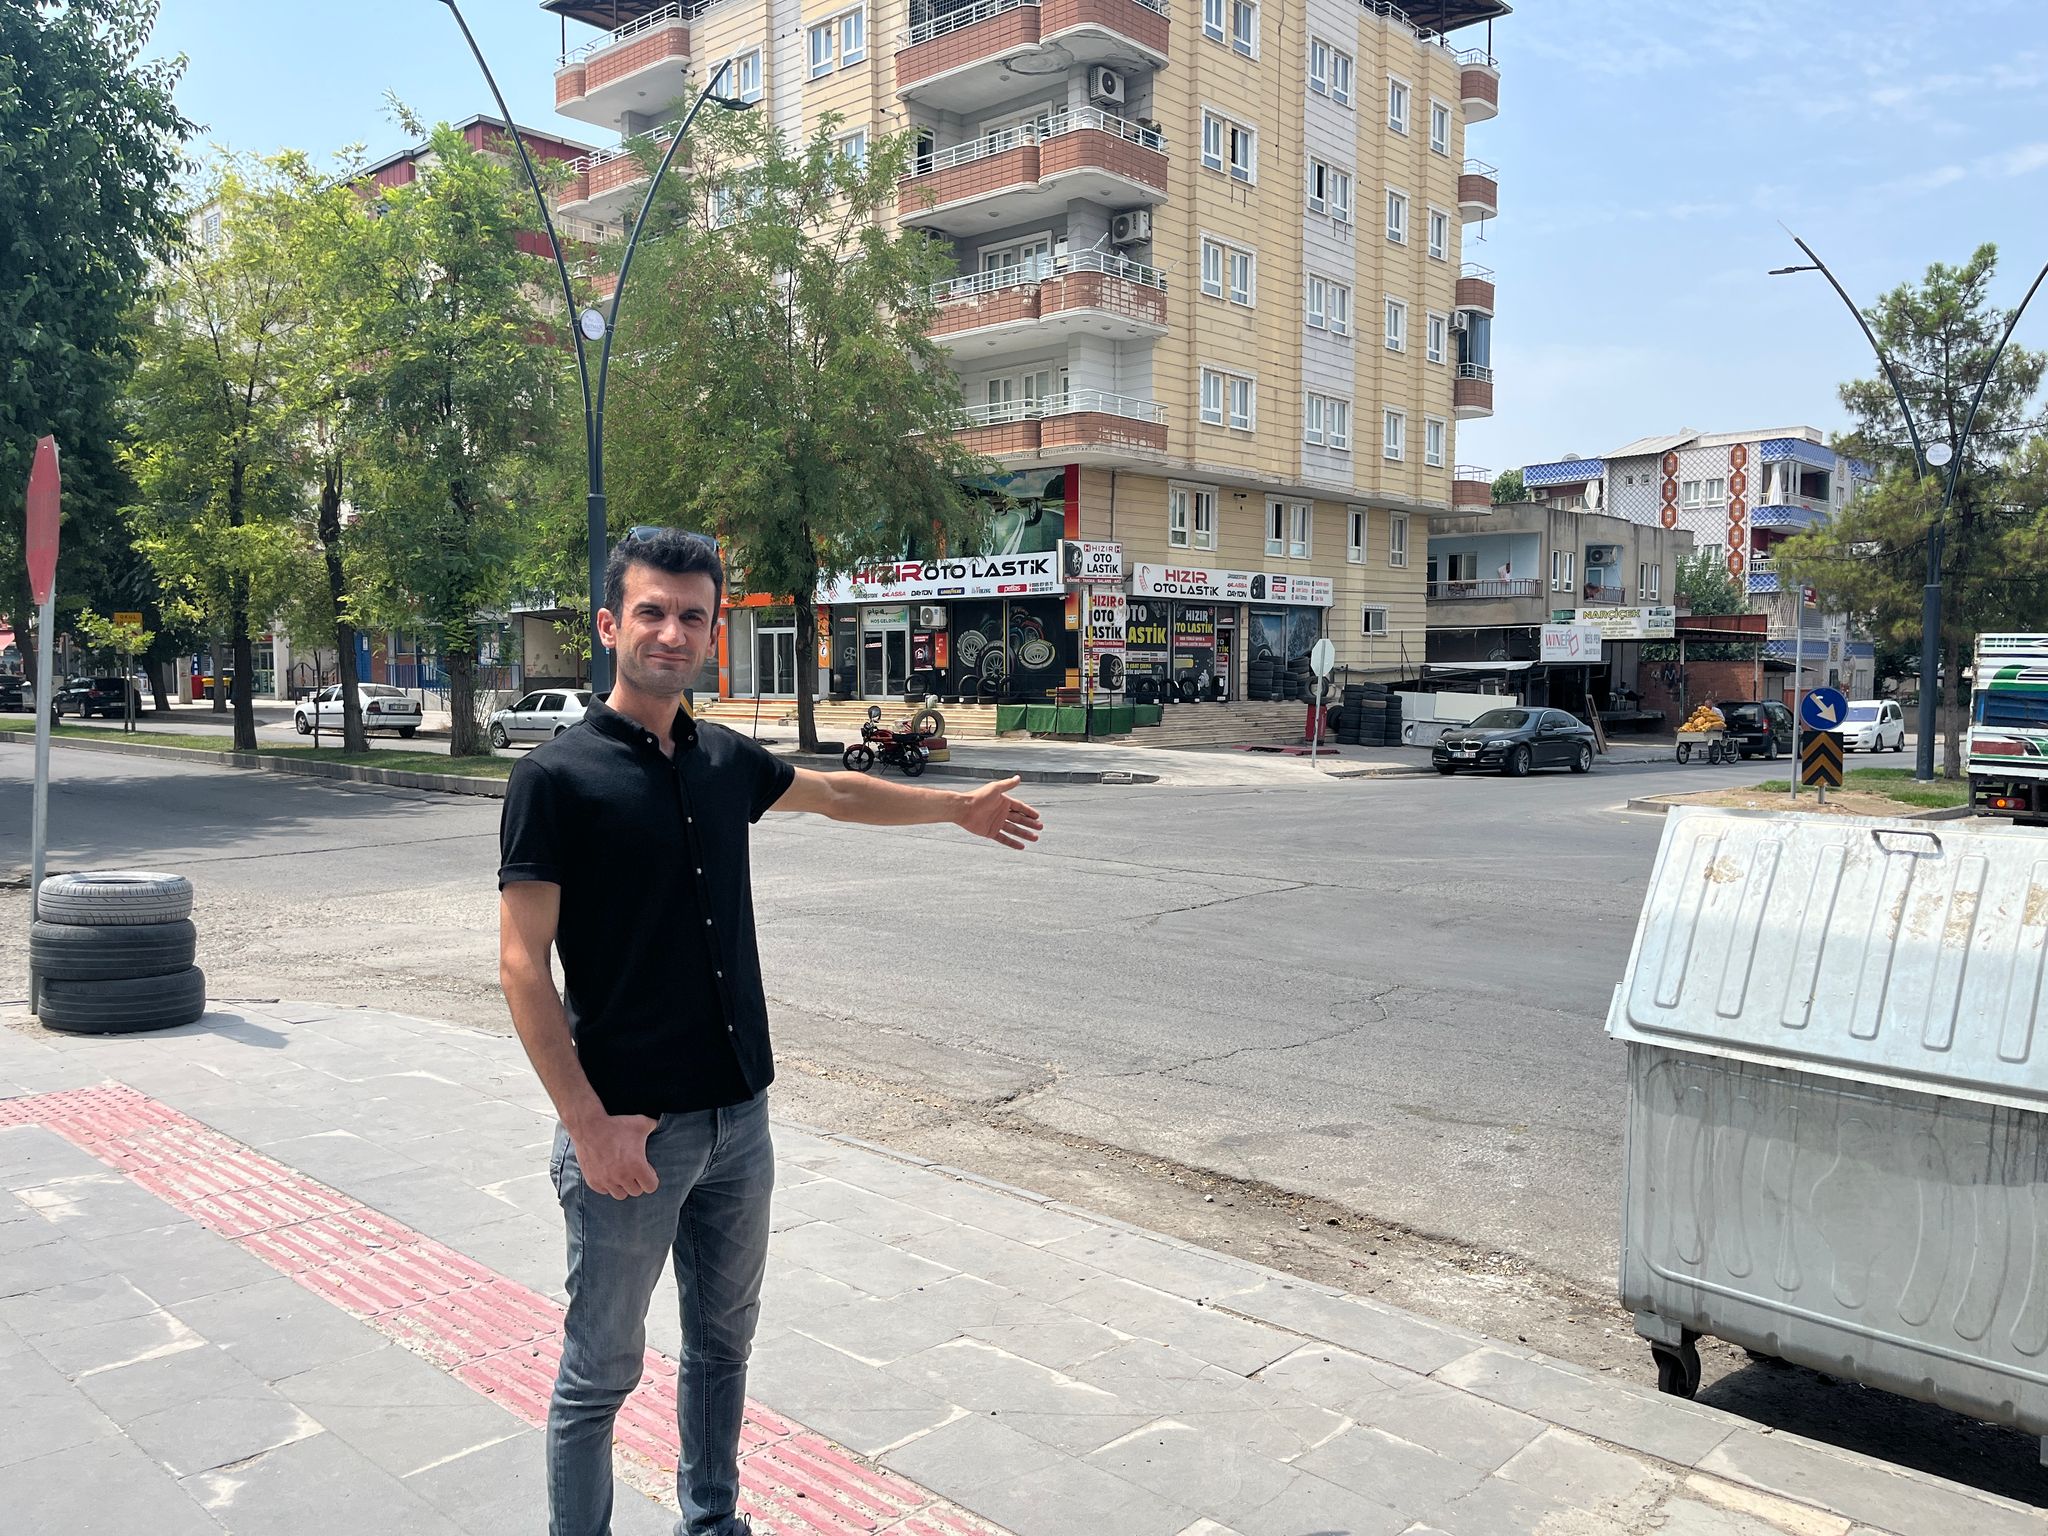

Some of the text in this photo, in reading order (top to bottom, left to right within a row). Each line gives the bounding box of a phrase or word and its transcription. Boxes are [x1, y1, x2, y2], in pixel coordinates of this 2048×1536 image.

[1093, 553, 1112, 563] OTO
[924, 565, 966, 580] OTO
[1165, 569, 1208, 585] HIZIR
[1153, 583, 1177, 593] OTO
[1093, 609, 1114, 622] OTO
[1185, 609, 1208, 621] HIZIR
[1583, 608, 1640, 621] NARÇİÇEK
[1126, 622, 1167, 644] ASTİK
[1175, 621, 1213, 633] TO LASTİK
